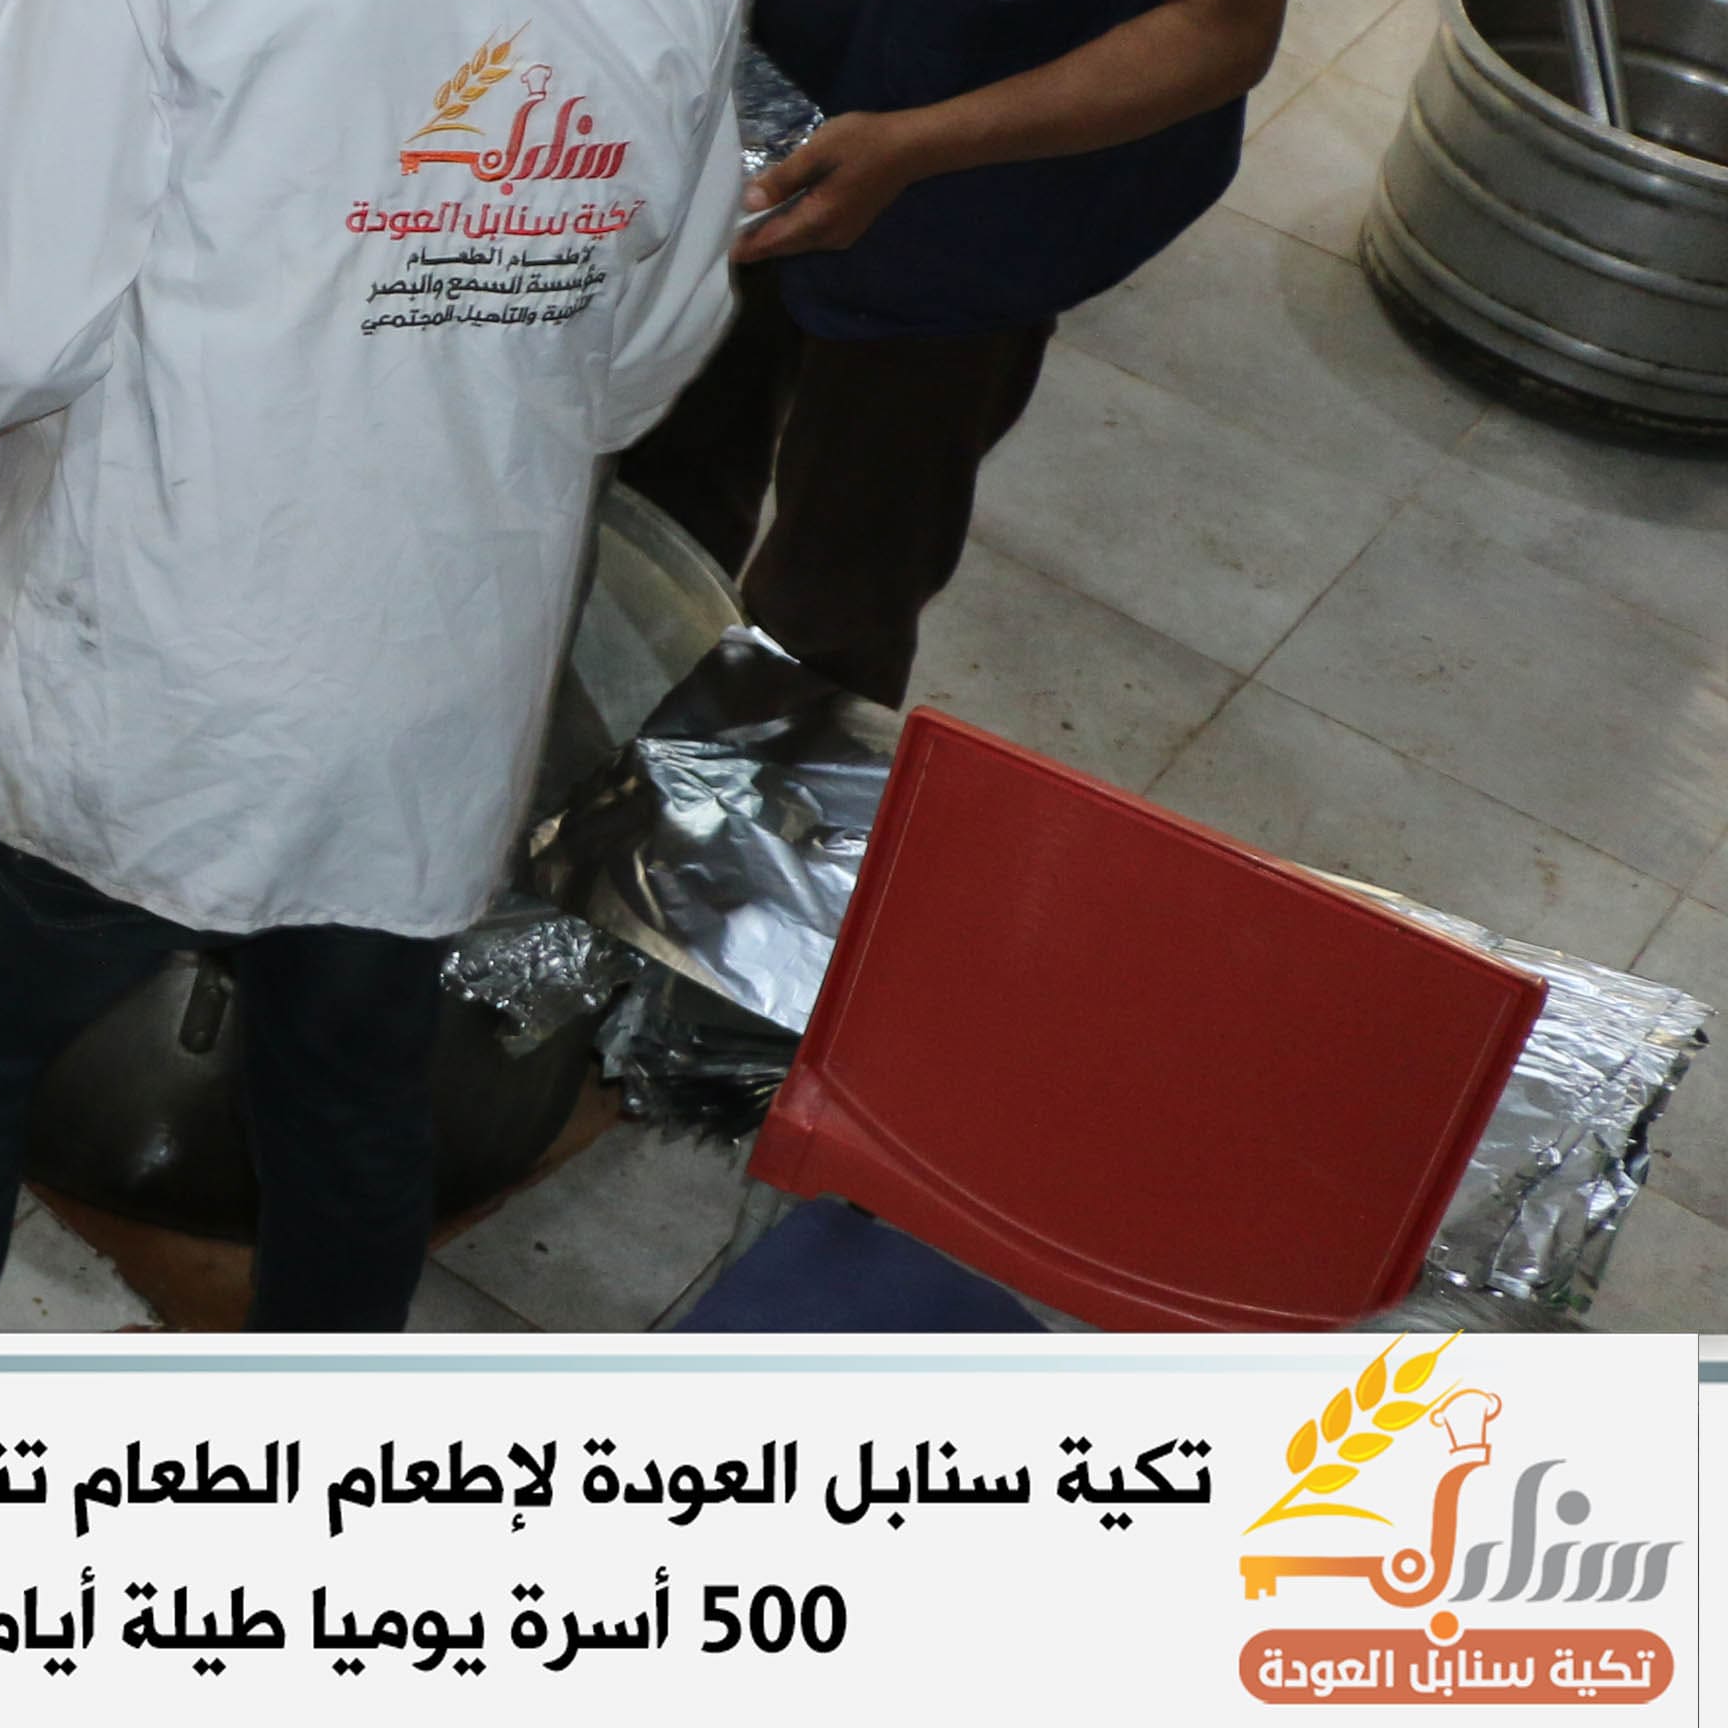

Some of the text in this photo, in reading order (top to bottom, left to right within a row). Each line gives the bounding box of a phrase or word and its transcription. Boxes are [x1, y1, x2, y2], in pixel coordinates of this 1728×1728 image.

[345, 199, 647, 242] تكية سنابل العودة
[367, 264, 608, 304] مؤسسة السمع والبصر
[359, 304, 456, 337] المجتمعي
